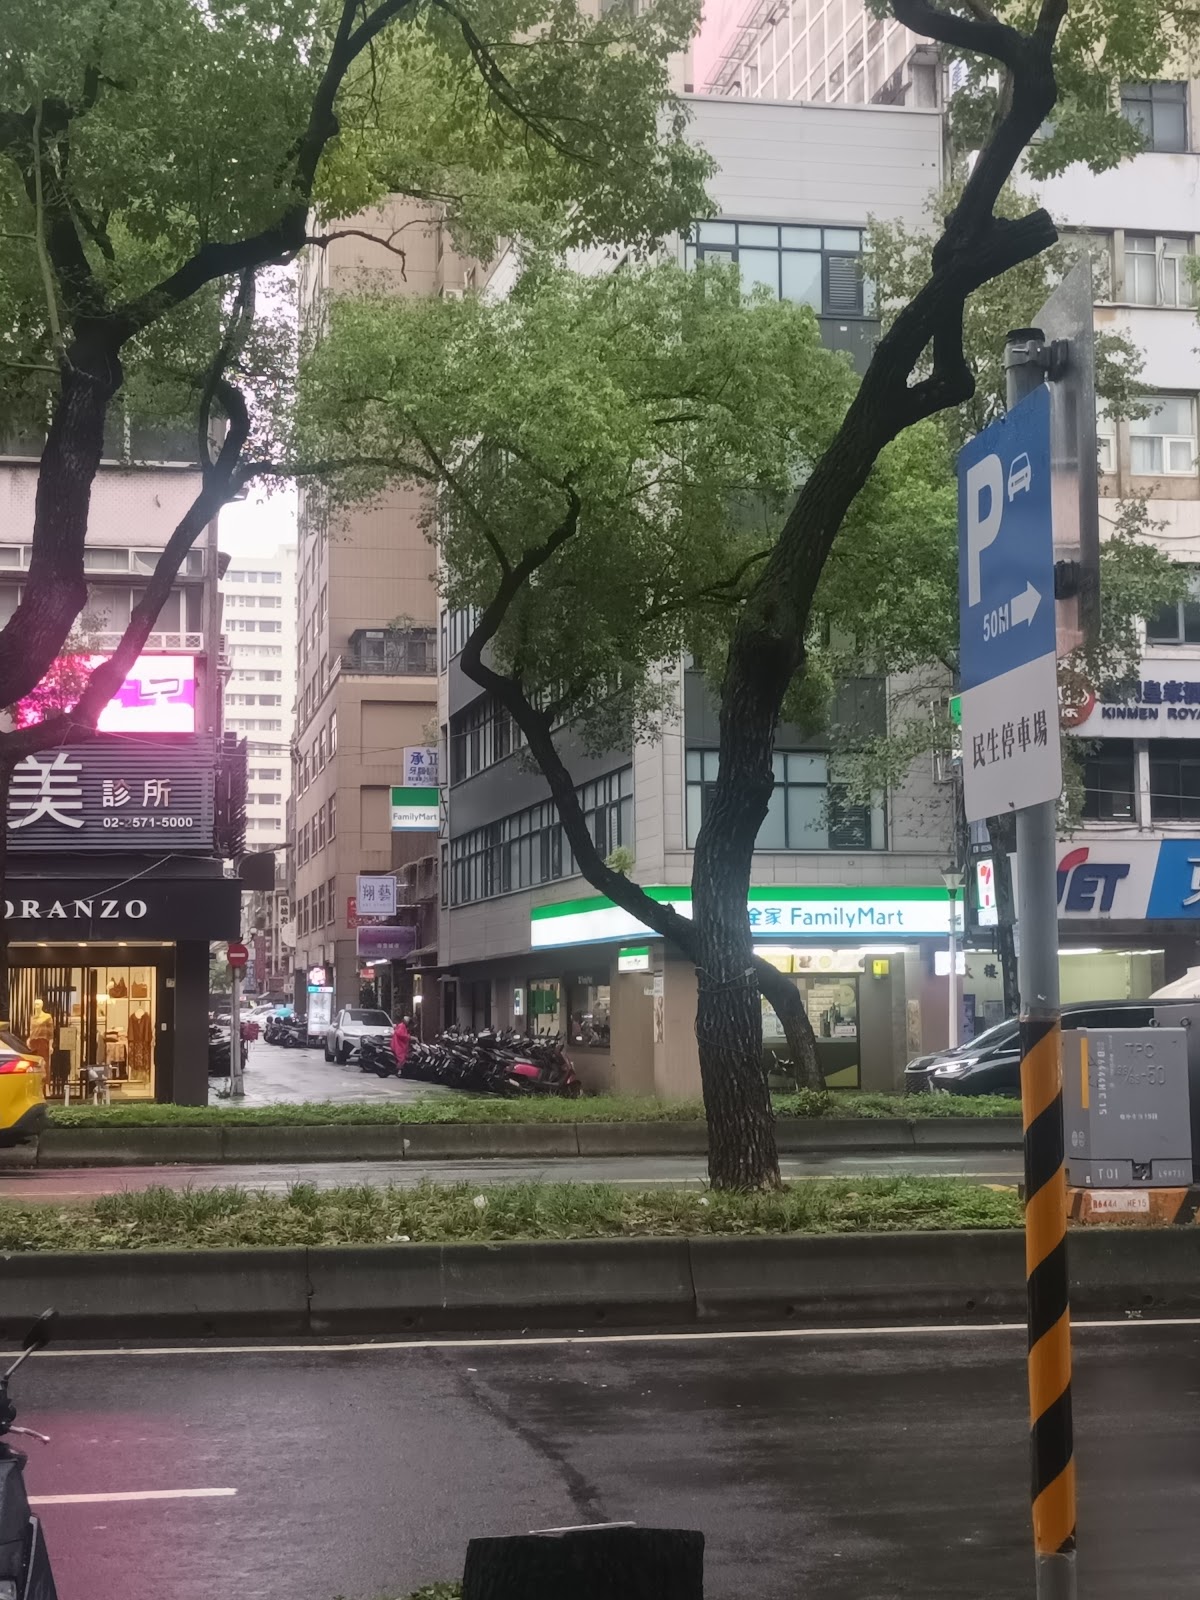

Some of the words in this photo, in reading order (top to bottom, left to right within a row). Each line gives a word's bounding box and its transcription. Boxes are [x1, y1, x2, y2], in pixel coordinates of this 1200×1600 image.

[967, 453, 1003, 607] P
[983, 605, 1009, 642] 50M
[1102, 707, 1159, 720] KINMEN
[972, 709, 1048, 770] 民生停車場
[7, 752, 85, 829] 美
[102, 778, 172, 807] 診所
[103, 817, 193, 828] 02-2571-5000
[393, 812, 437, 822] FamilyMart
[748, 907, 782, 925] 全家
[790, 907, 904, 928] FamilyMart
